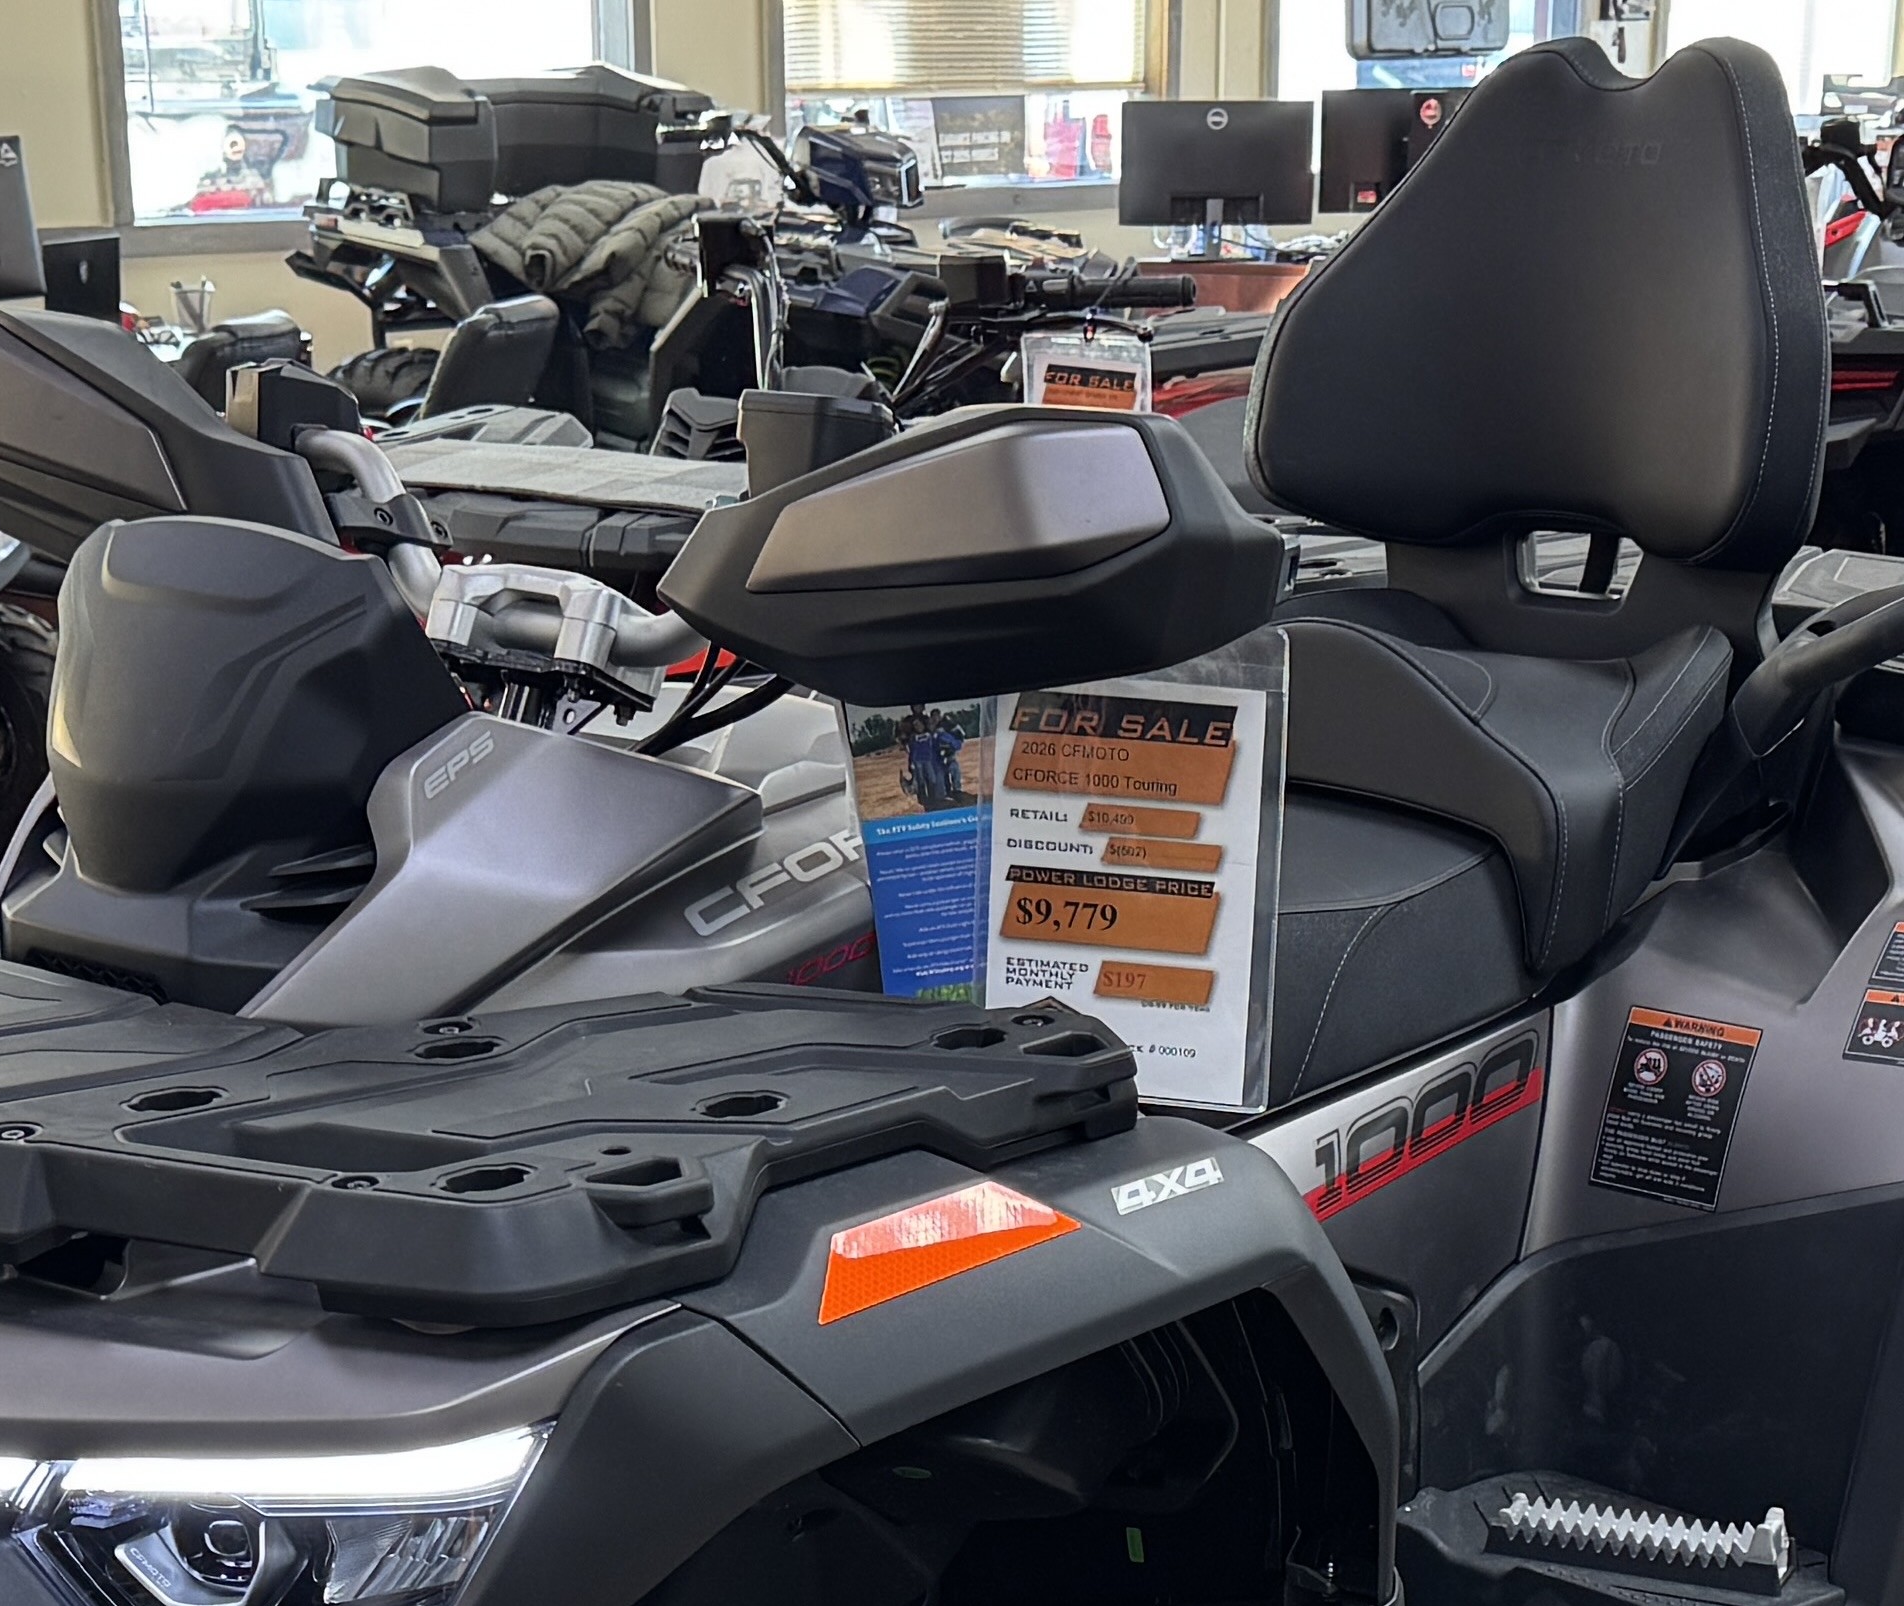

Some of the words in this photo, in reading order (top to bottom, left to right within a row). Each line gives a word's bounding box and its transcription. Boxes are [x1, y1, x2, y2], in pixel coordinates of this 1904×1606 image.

[1045, 372, 1082, 386] FOR
[1088, 375, 1135, 392] SALE
[1013, 708, 1100, 735] FOR
[1117, 714, 1233, 746] SALE
[423, 730, 495, 799] EPS
[1021, 741, 1056, 756] 2026
[1062, 743, 1130, 761] CFMOTO
[1013, 768, 1079, 785] CFORCE
[1086, 773, 1120, 789] 1000
[1124, 776, 1178, 796] Touring
[1008, 868, 1076, 886] POWER
[1083, 872, 1149, 892] LODGE
[1155, 880, 1214, 897] PRICE
[1016, 897, 1118, 932] $9,779
[1006, 957, 1089, 973] ESTIMATED
[1006, 967, 1075, 980] MONTHLY
[1005, 976, 1073, 990] PAYMENT
[1102, 971, 1147, 990] $197
[1673, 1018, 1727, 1038] WARNING
[1314, 1038, 1538, 1212] 1000
[1115, 1157, 1223, 1214] 4X4
[130, 1547, 171, 1588] CFMOTO
